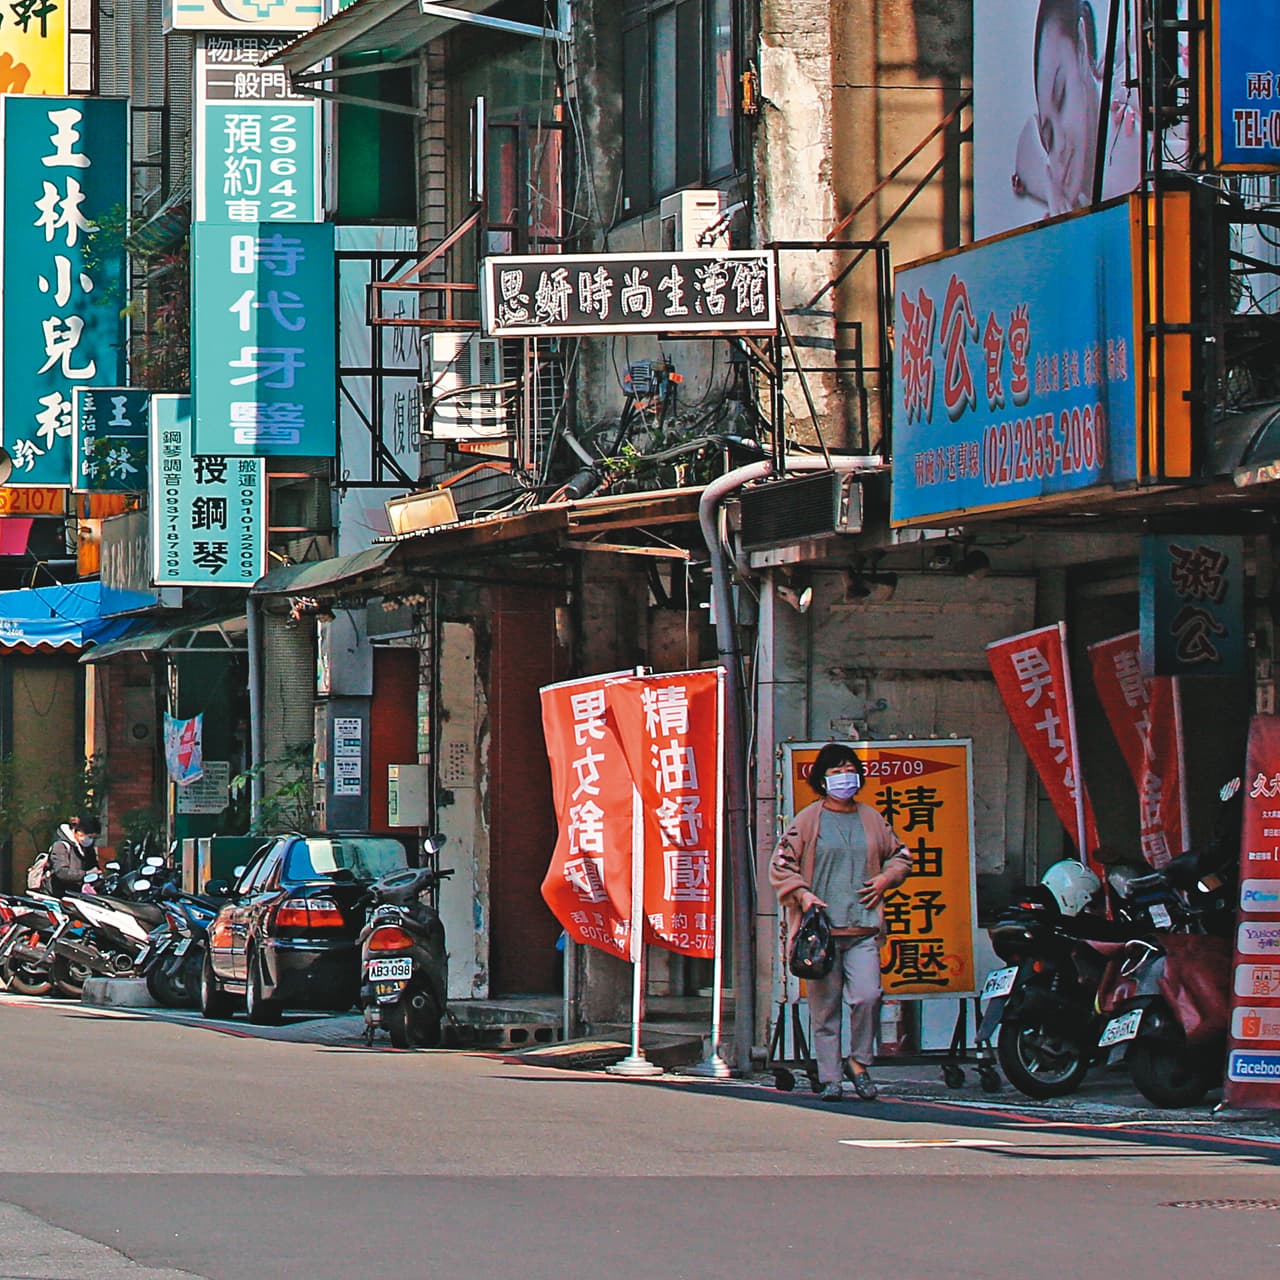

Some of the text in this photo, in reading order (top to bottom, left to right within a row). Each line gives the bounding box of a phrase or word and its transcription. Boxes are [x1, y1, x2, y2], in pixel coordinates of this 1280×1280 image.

[207, 37, 285, 64] 物理治
[34, 107, 100, 451] 王林小兒科
[229, 233, 307, 447] 時代牙醫
[163, 431, 183, 486] 鋼琴調音
[982, 401, 1107, 489] (02)2955-2060
[640, 685, 711, 903] 精油舒壓
